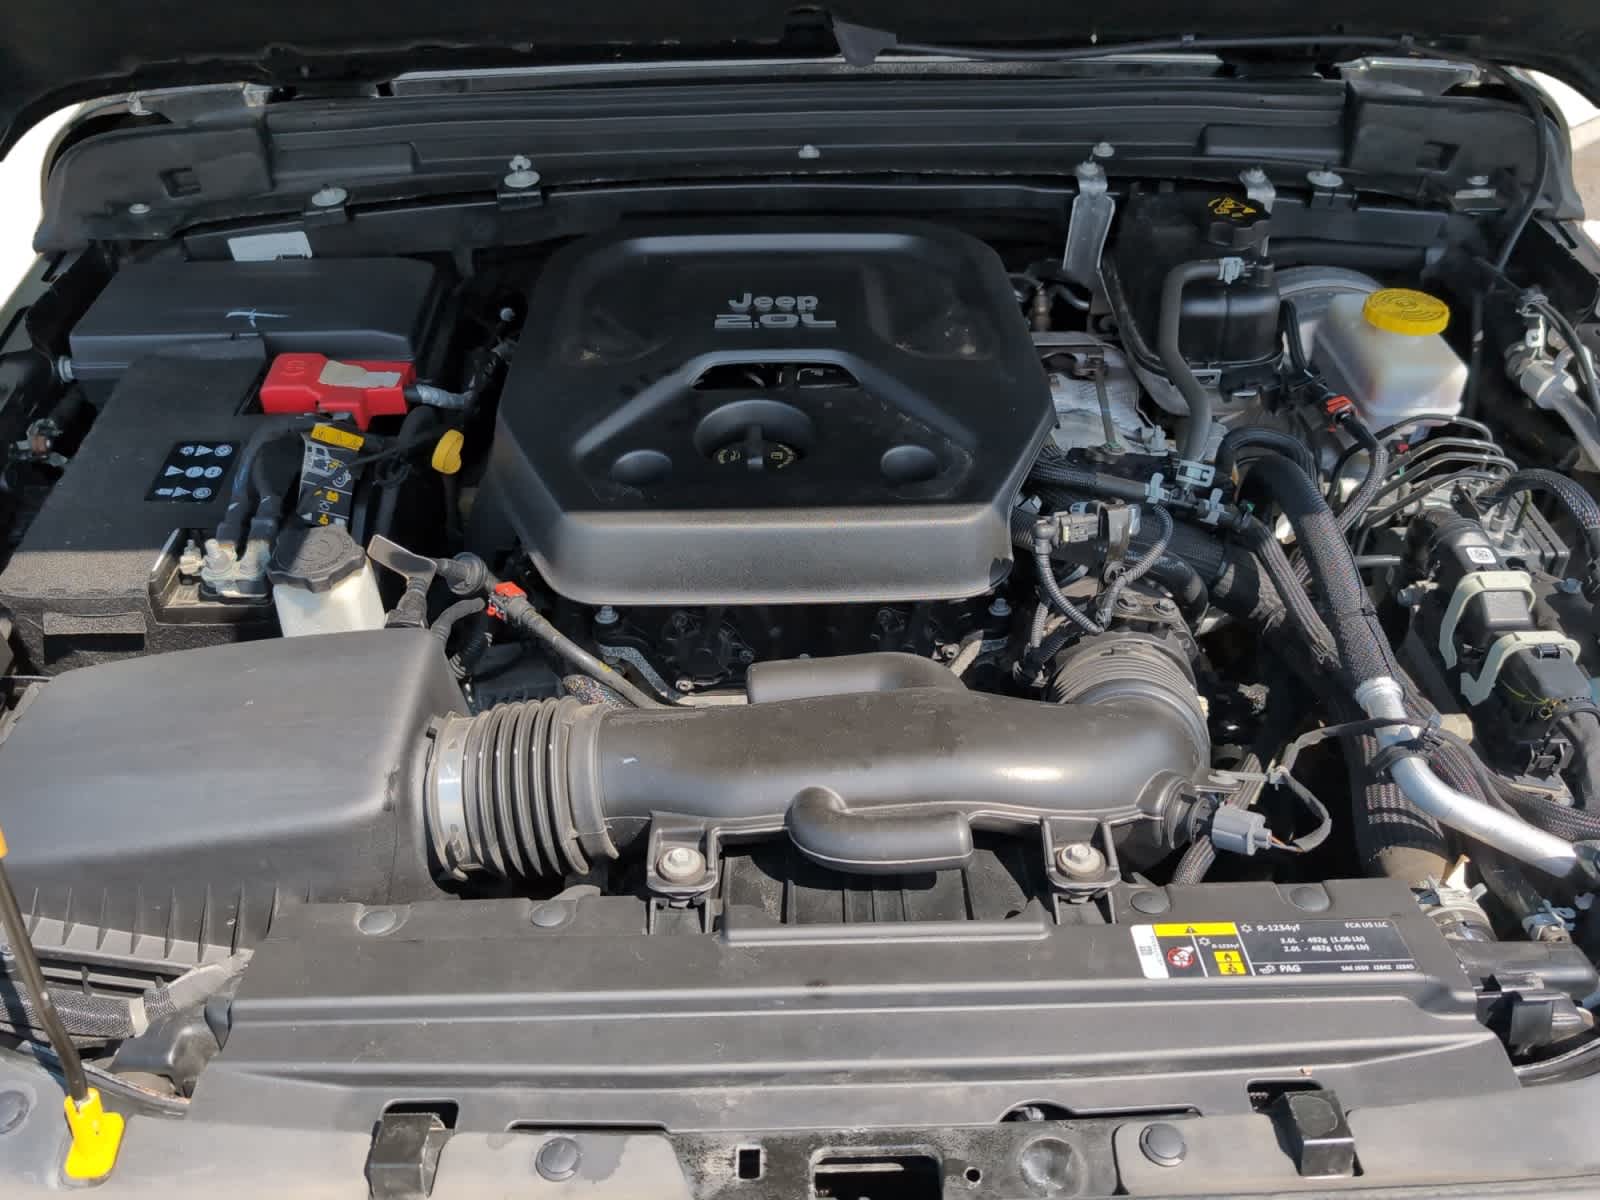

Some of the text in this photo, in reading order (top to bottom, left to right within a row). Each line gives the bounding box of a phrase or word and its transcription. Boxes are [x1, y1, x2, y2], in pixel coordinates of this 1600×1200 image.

[728, 292, 819, 314] Jeep
[714, 313, 837, 329] 2.0L
[1256, 923, 1301, 932] R-1234yf
[1279, 964, 1301, 973] PAG
